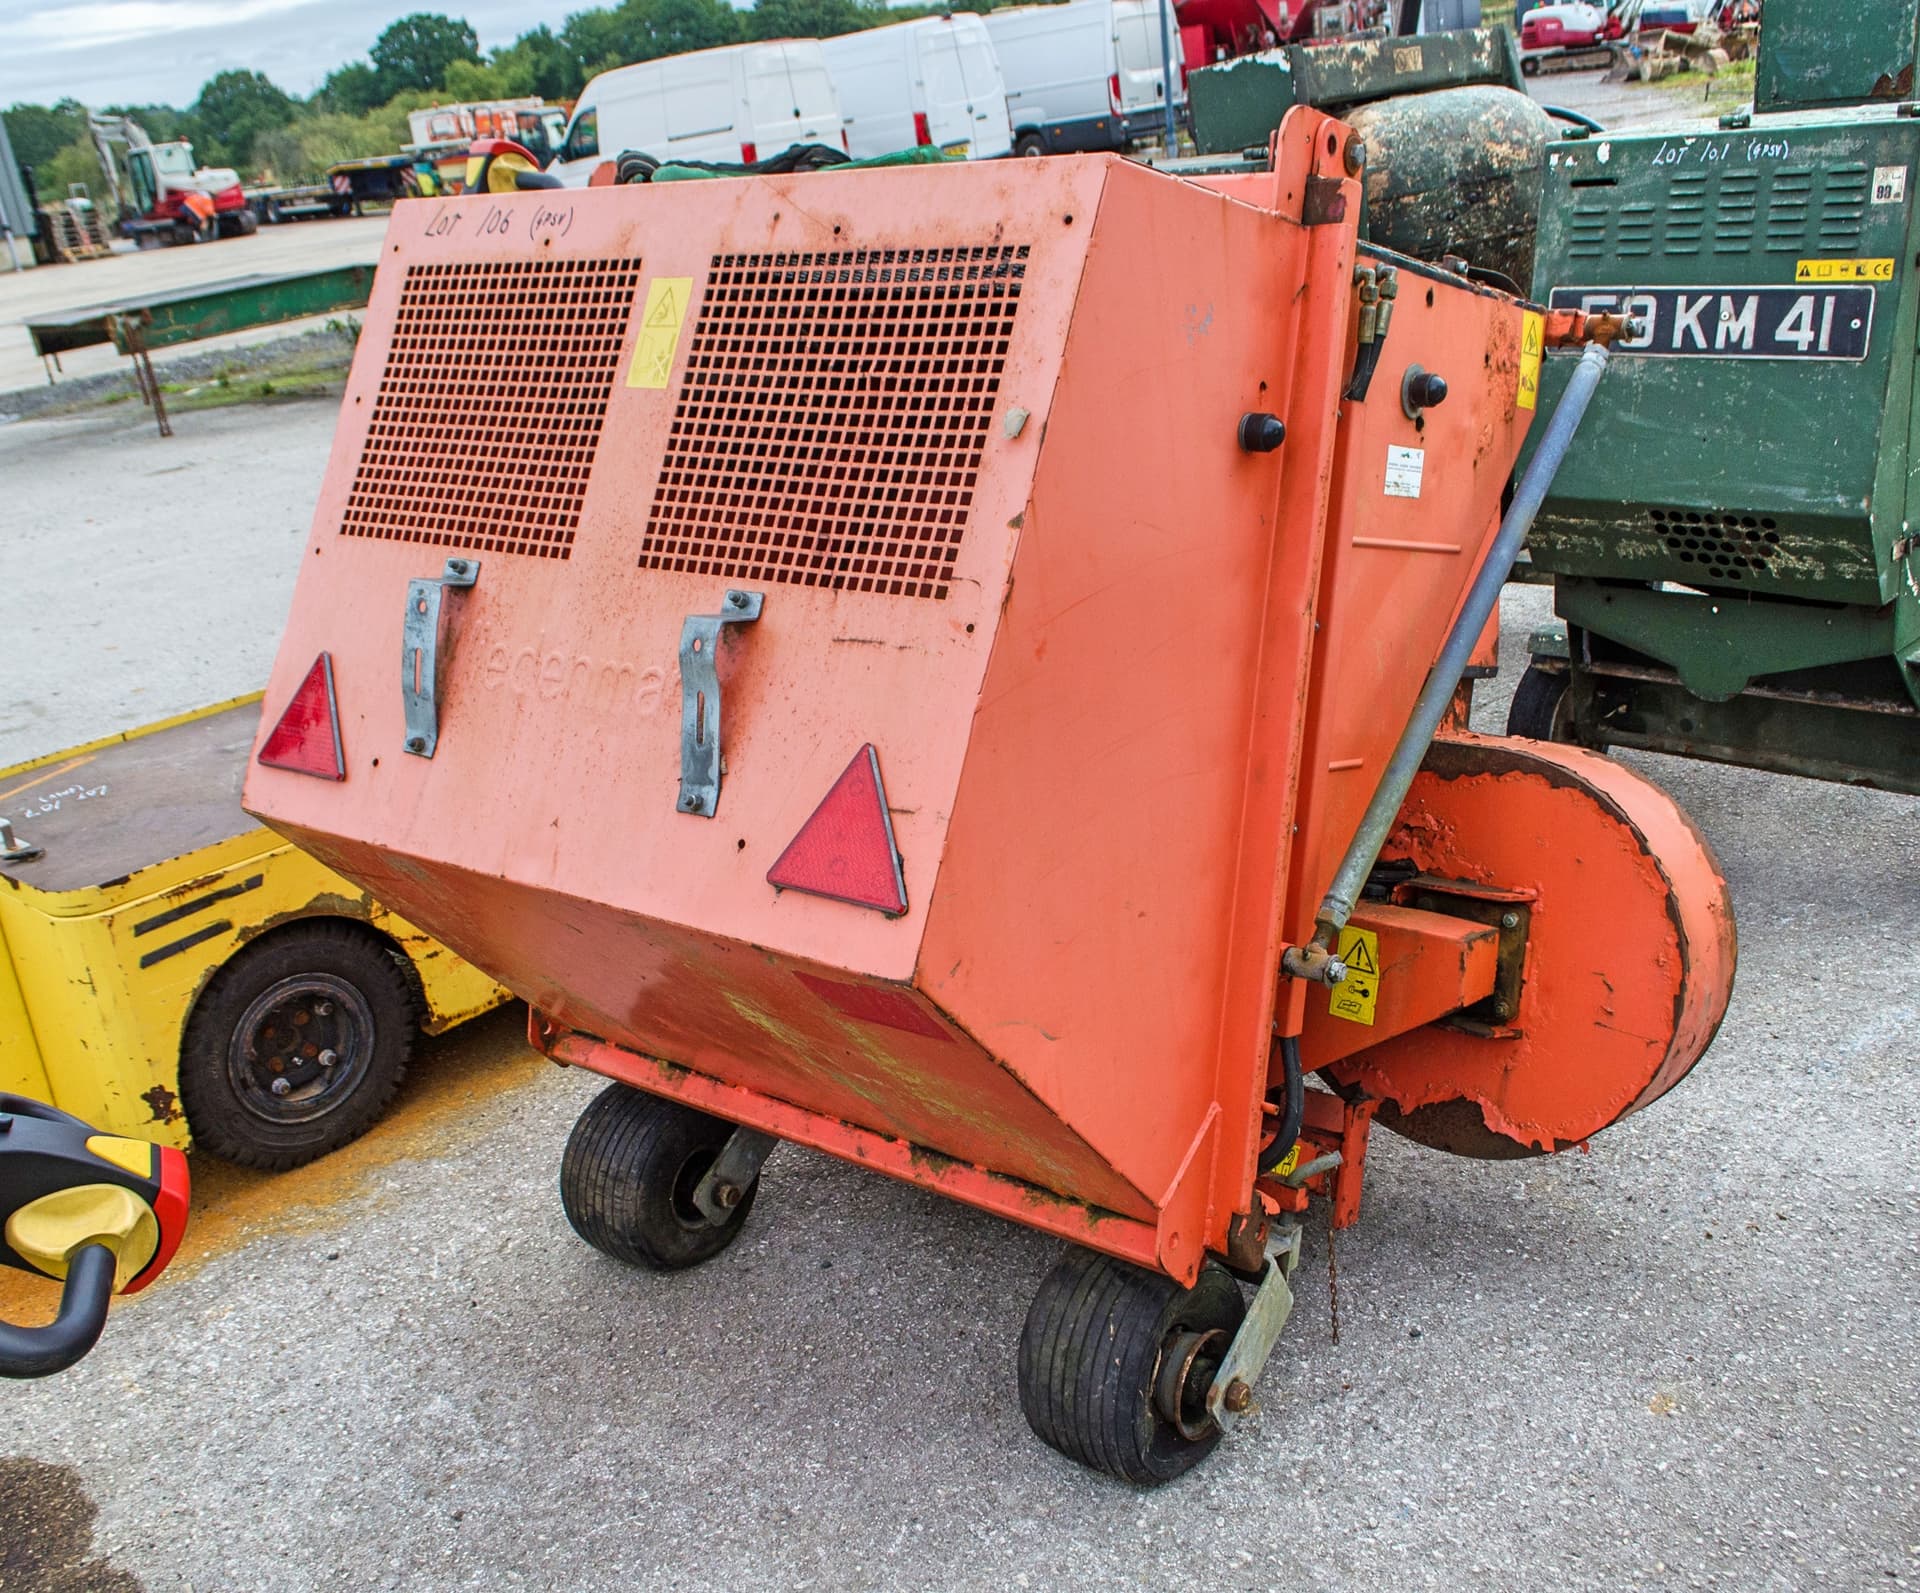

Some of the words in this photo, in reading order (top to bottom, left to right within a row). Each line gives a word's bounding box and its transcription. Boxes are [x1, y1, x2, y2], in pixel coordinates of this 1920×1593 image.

[1652, 140, 1689, 165] LOT
[424, 204, 462, 237] LOT
[476, 204, 514, 237] 106
[1672, 295, 1760, 350] KM
[1774, 295, 1836, 352] 41
